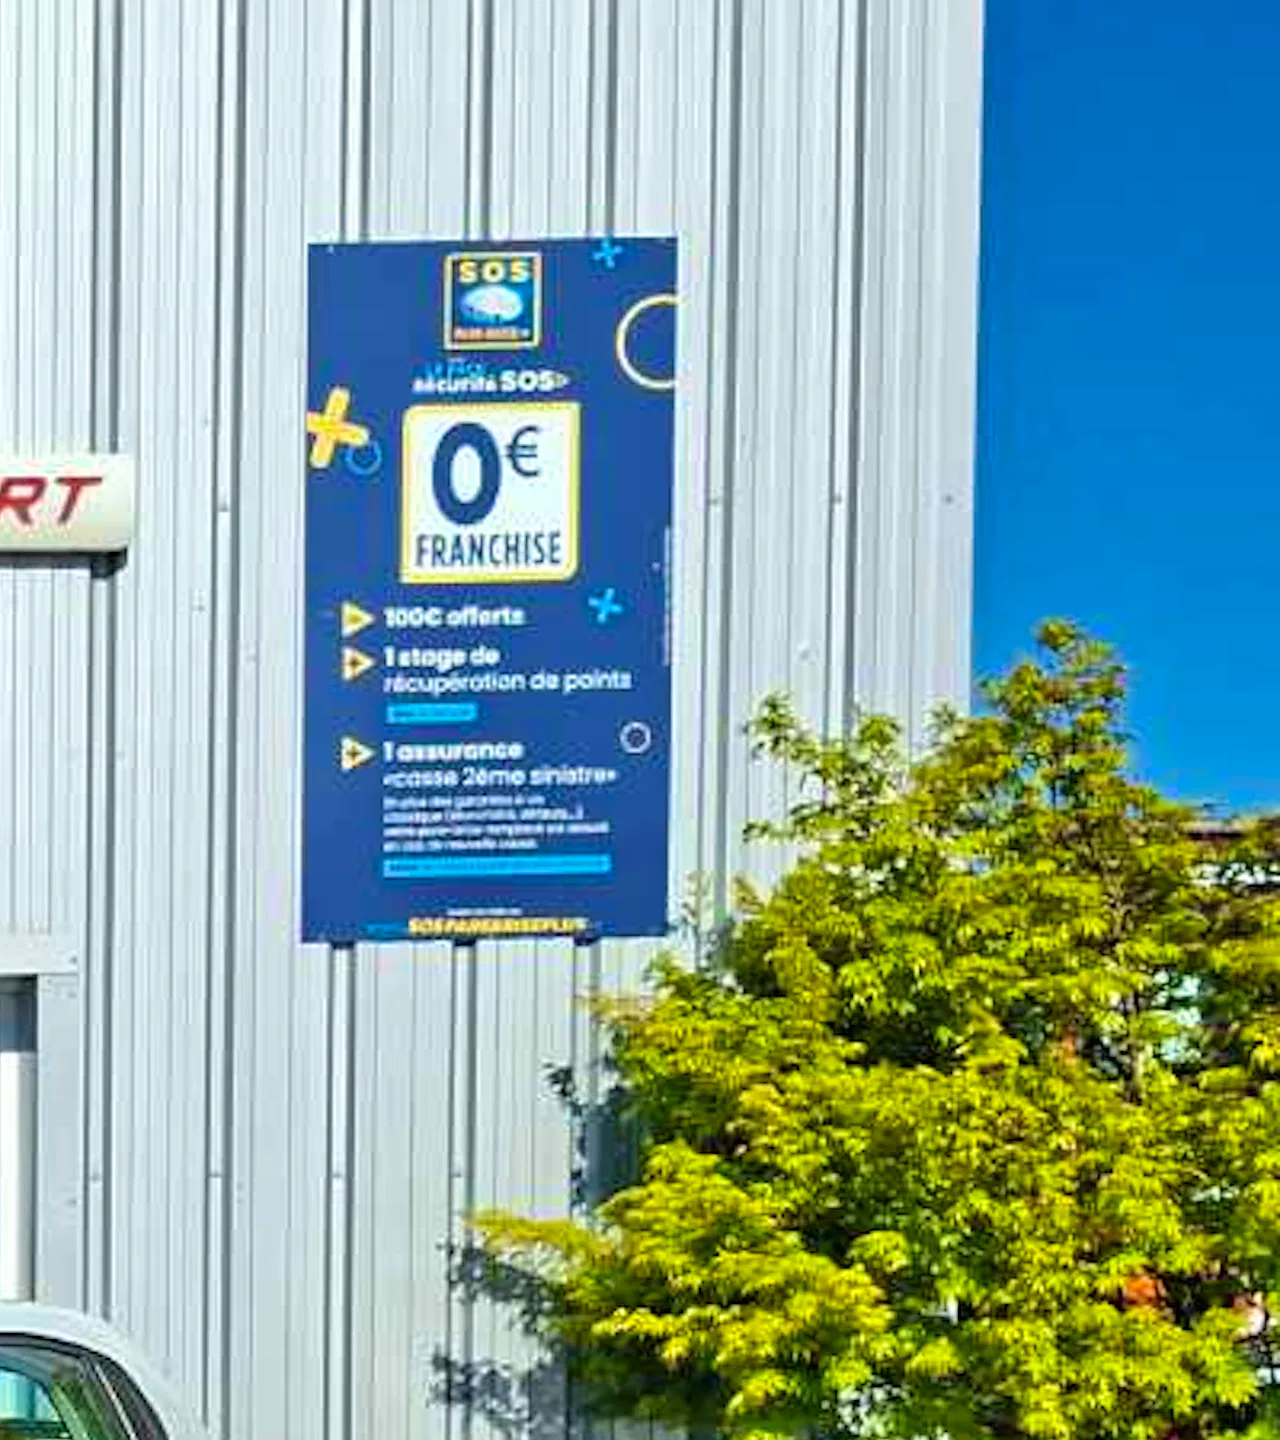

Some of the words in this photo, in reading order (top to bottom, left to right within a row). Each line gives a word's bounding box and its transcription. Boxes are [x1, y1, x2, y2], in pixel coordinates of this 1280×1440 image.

[459, 259, 530, 283] SOS
[416, 532, 562, 567] FRANCHISE
[446, 606, 525, 627] offerts
[398, 647, 467, 672] stage
[469, 645, 500, 666] de
[530, 670, 559, 690] de
[563, 669, 632, 694] points
[397, 742, 524, 762] assurance
